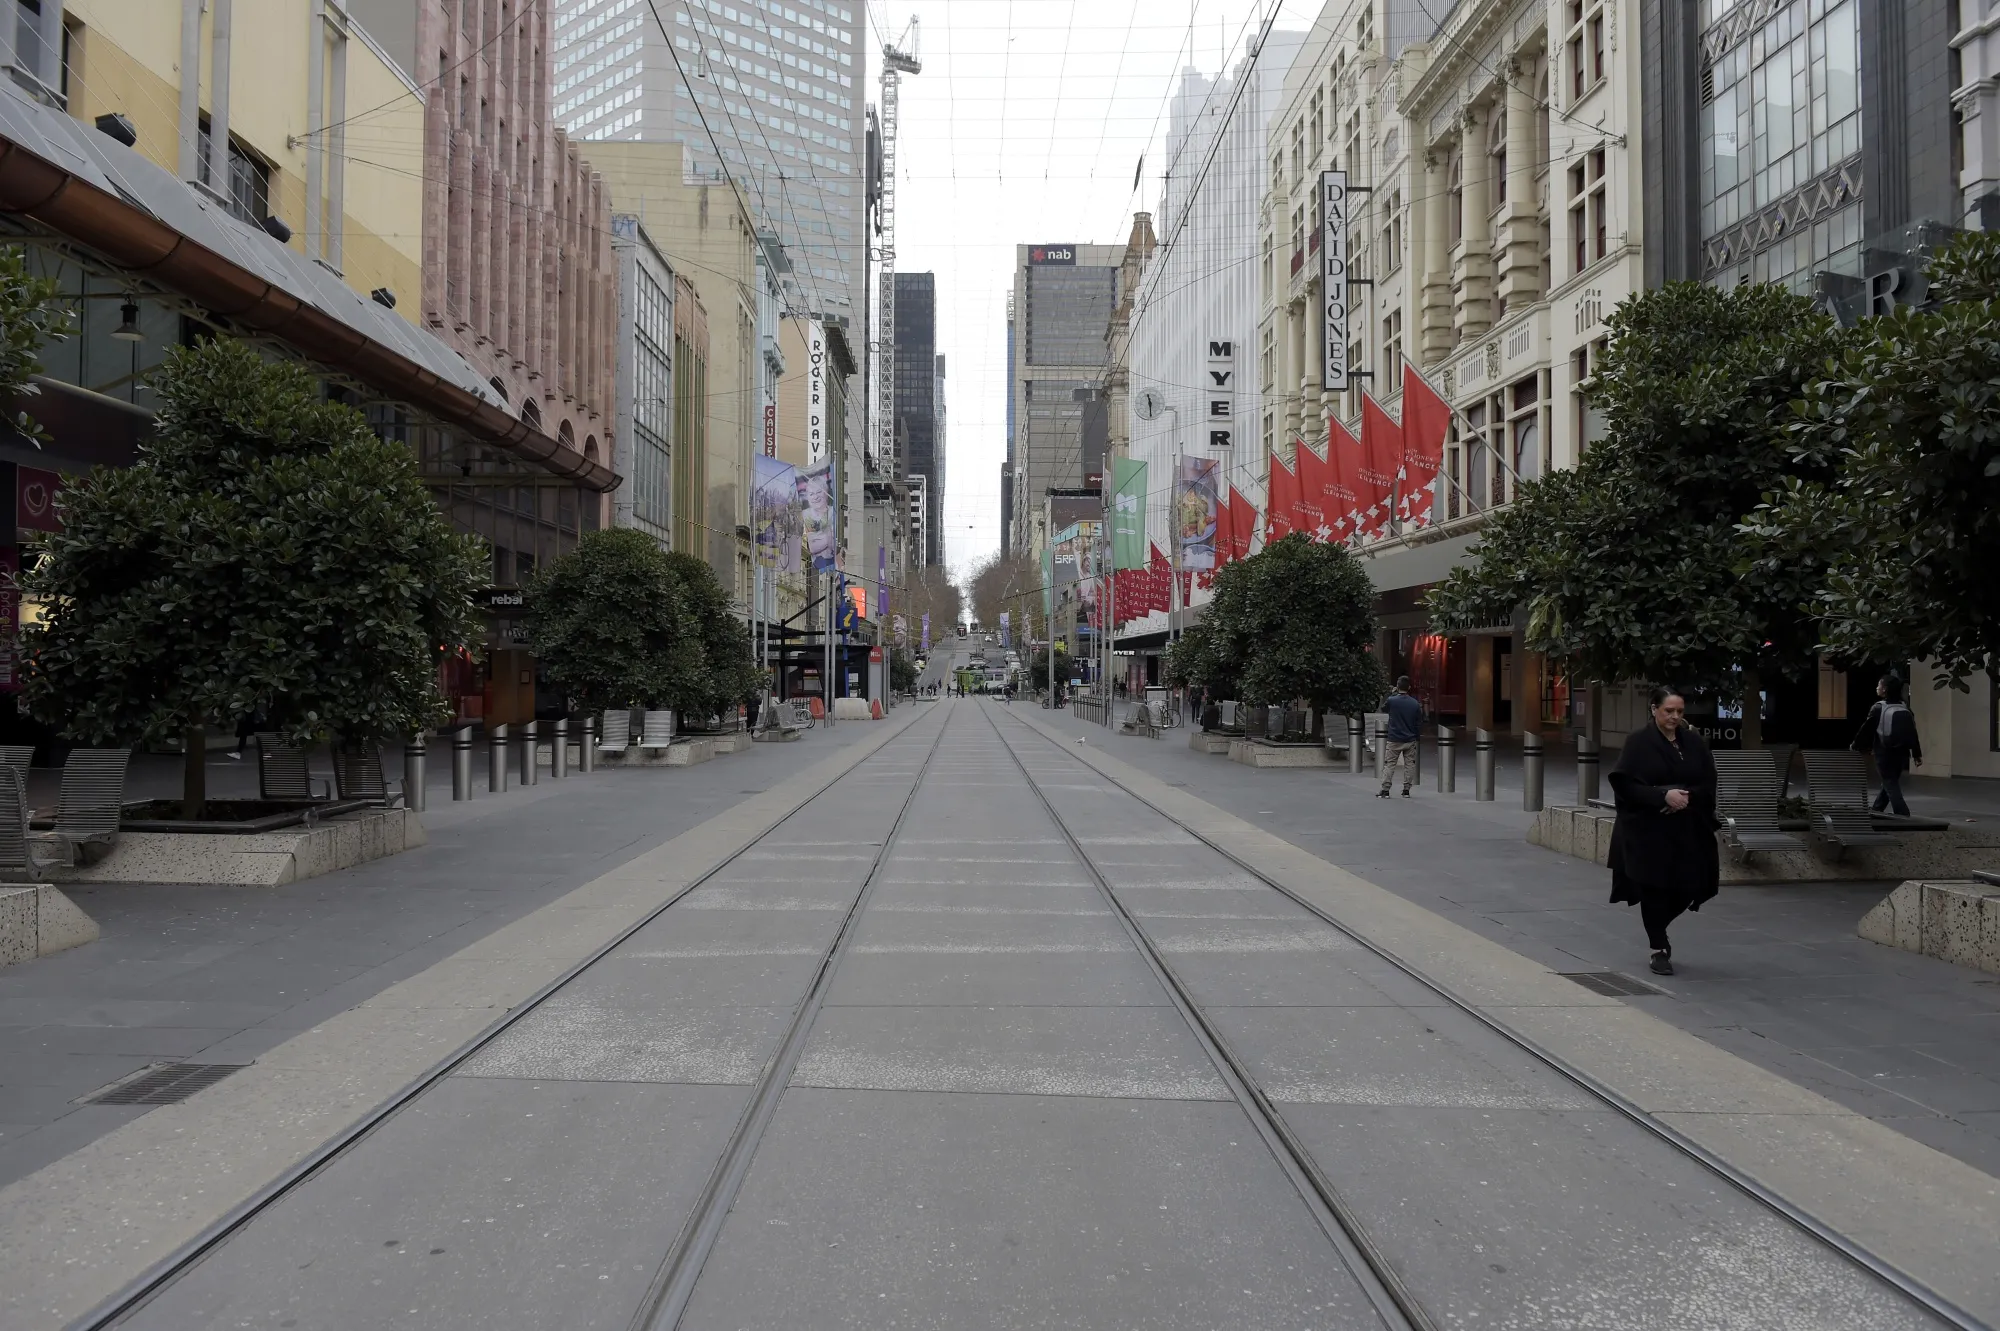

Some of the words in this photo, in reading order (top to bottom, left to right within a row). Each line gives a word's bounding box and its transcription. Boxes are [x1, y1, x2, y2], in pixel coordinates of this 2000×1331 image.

[1327, 184, 1344, 275] DAVID
[1047, 248, 1072, 260] nab
[1327, 283, 1345, 379] JONES
[811, 340, 822, 405] ROGER
[1209, 341, 1232, 446] MYER
[766, 408, 774, 459] CAUSE
[811, 415, 820, 464] DAVI
[1130, 582, 1150, 591] SALE
[1131, 573, 1150, 582] SALE
[491, 593, 523, 605] rebel
[1128, 599, 1149, 608] SALE
[1150, 592, 1169, 602] SALE
